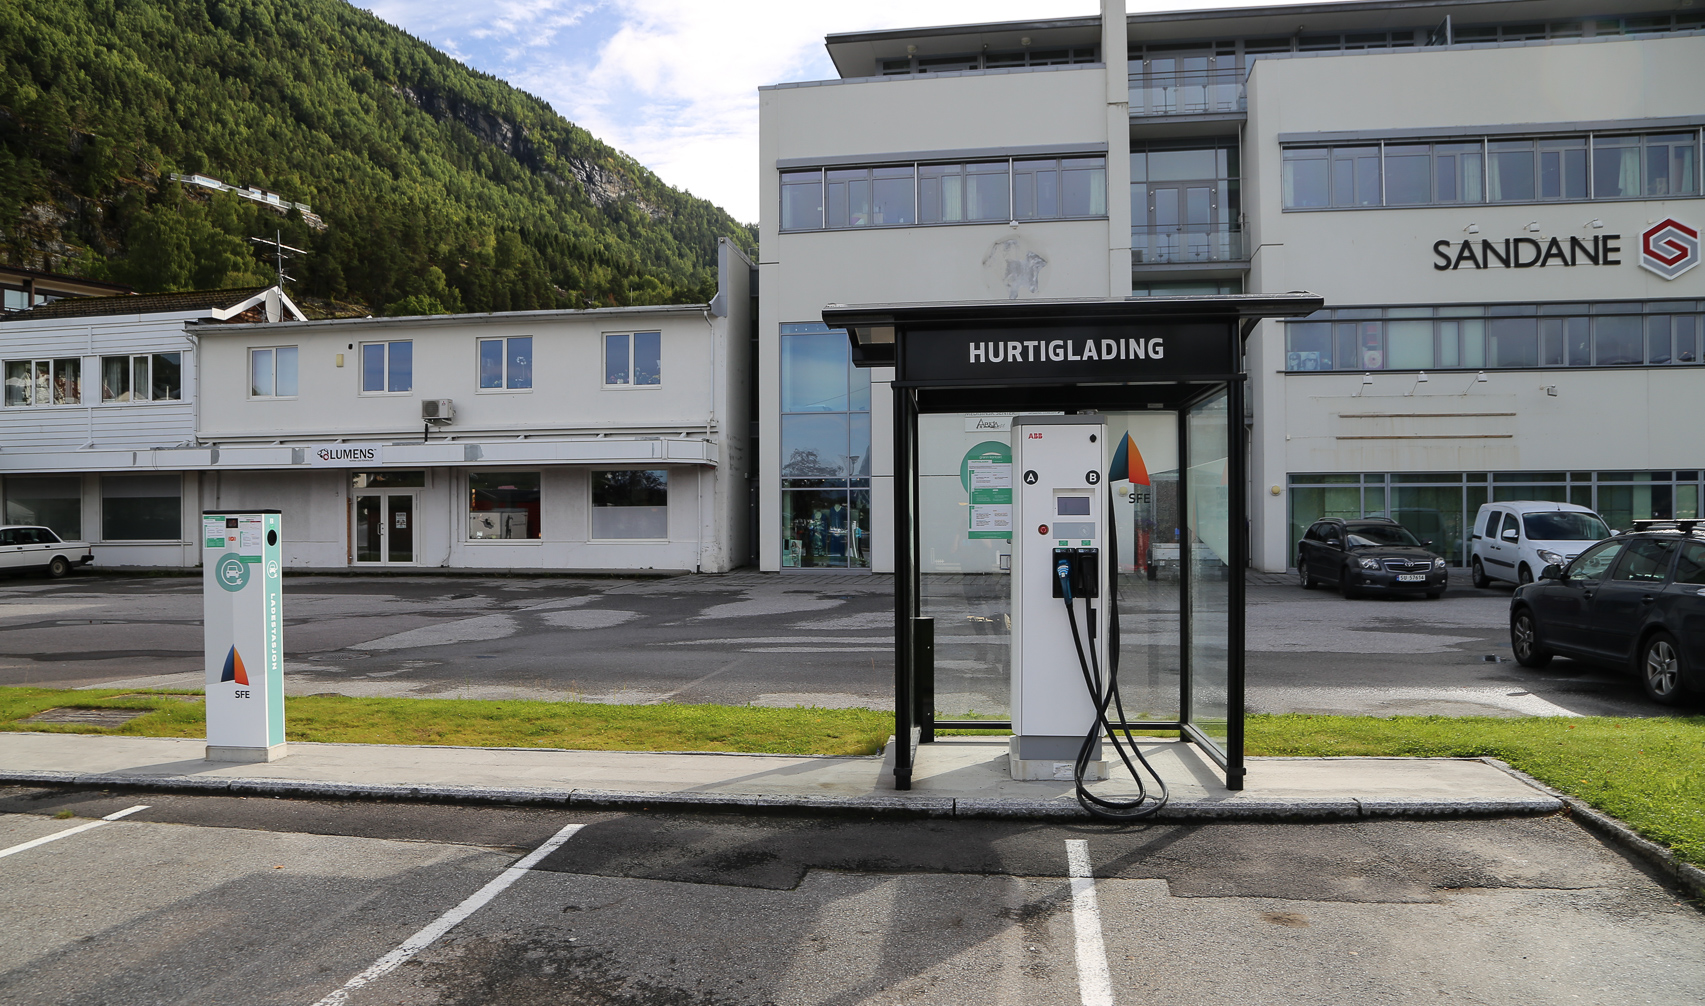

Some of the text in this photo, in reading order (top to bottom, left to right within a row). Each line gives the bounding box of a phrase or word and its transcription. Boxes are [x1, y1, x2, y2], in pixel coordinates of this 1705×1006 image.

[1433, 234, 1621, 271] SANDANE
[969, 337, 1164, 363] HURTIGLADING
[330, 448, 375, 460] LUMENS
[1026, 473, 1036, 482] A
[1089, 473, 1097, 482] B
[1128, 493, 1151, 504] SFE
[270, 593, 278, 670] LADESTASJON
[235, 690, 250, 699] SFE
